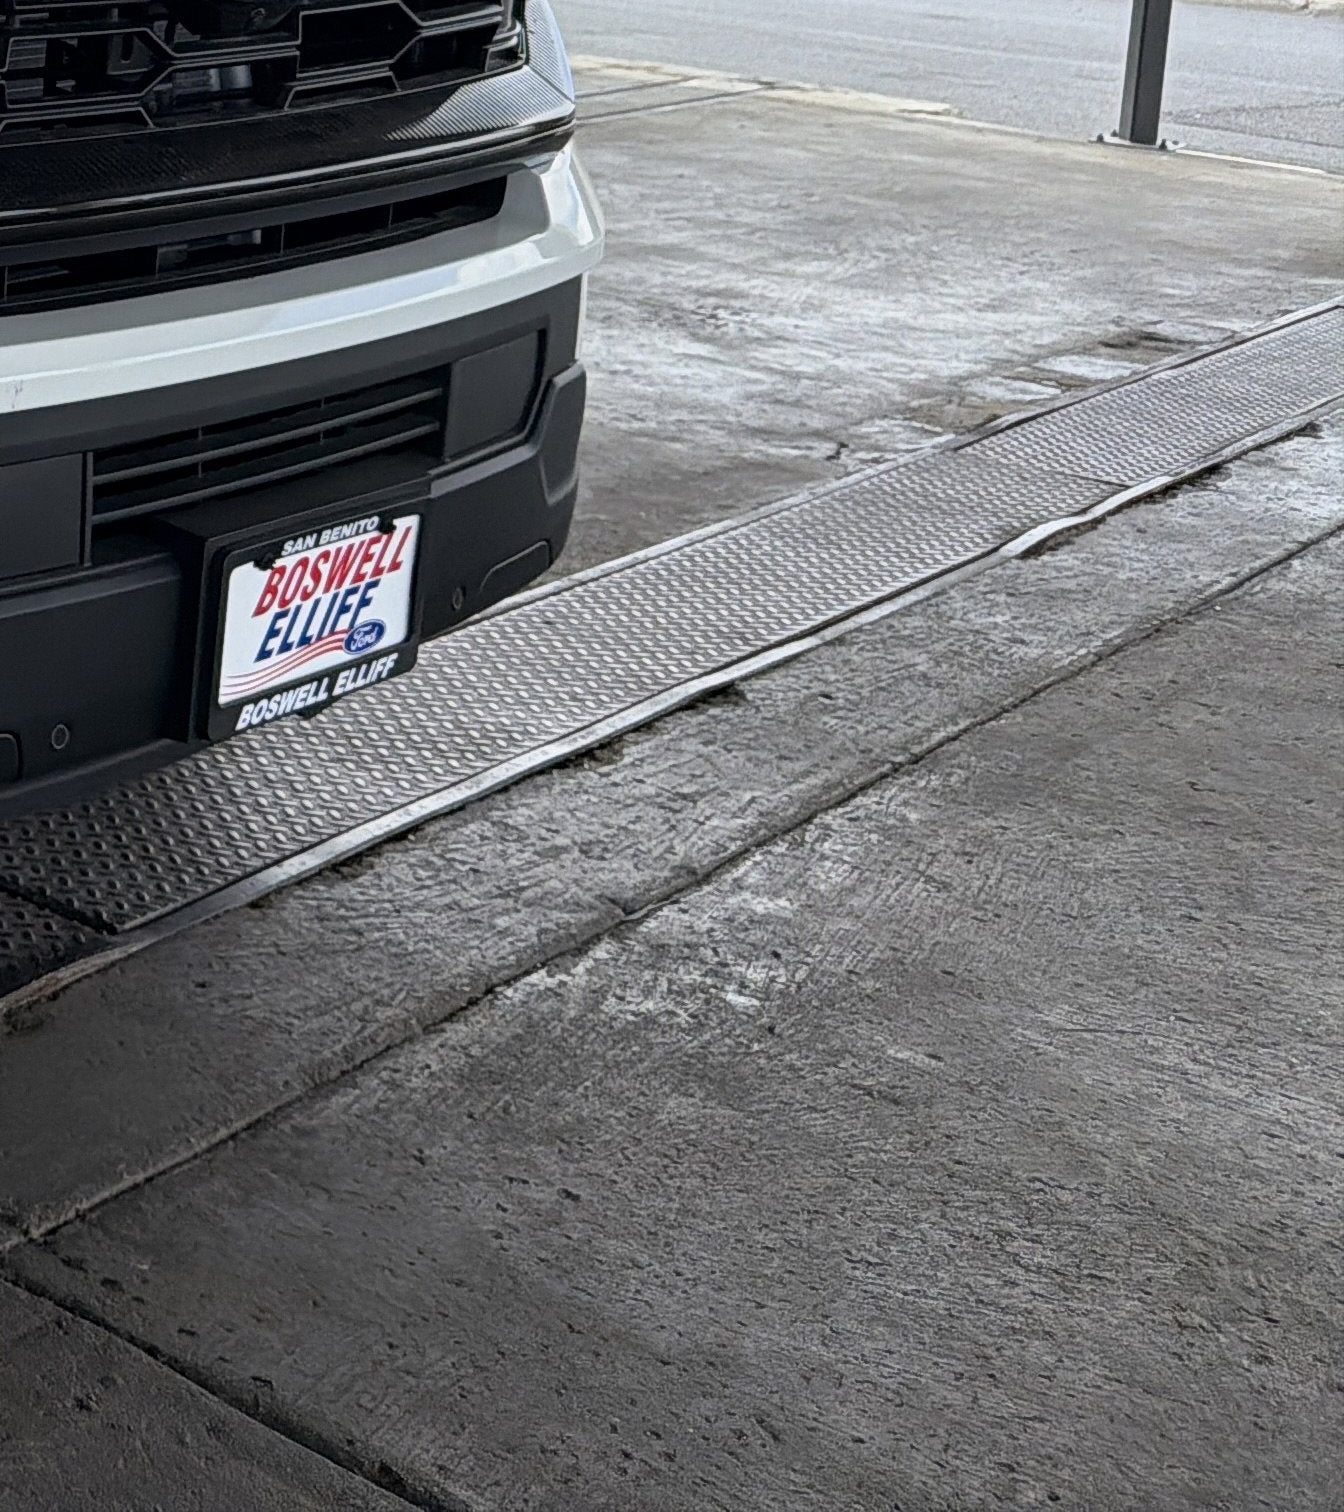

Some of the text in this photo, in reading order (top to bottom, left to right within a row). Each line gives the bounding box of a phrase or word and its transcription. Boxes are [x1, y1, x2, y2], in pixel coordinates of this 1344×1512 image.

[251, 525, 412, 617] BOSWELL
[282, 516, 379, 556] SAN BENITO
[253, 578, 381, 663] ELLIFF
[350, 625, 379, 649] Ford
[235, 653, 398, 731] BOSWELL ELLIFF
